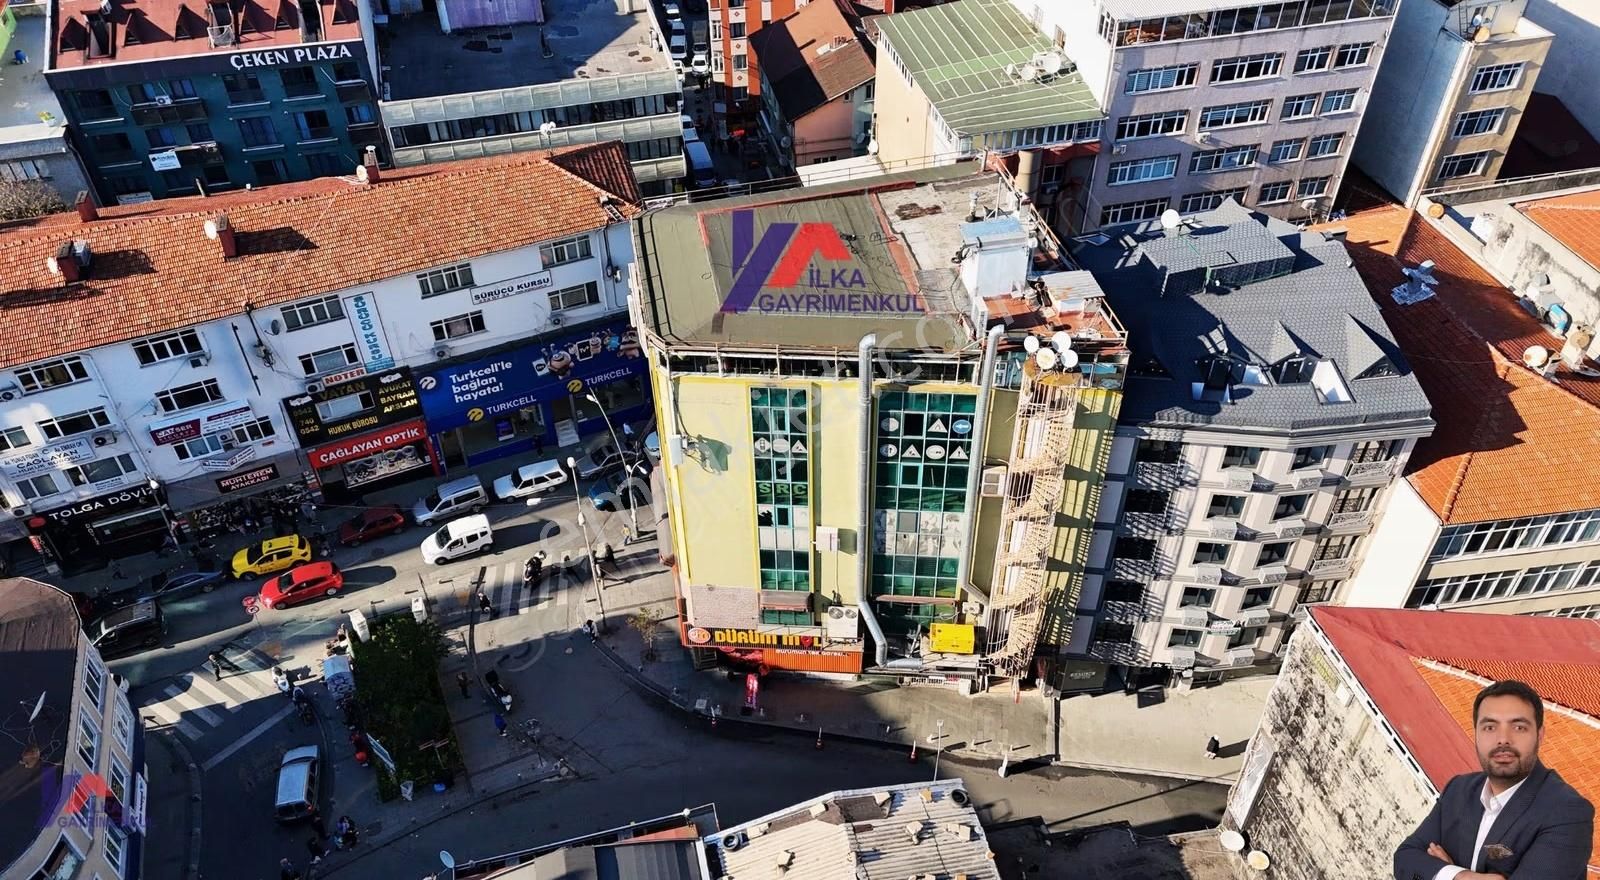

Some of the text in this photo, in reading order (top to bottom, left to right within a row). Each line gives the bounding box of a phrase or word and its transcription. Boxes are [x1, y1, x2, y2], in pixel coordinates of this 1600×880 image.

[230, 44, 352, 71] ÇEKEN PLAZA
[474, 286, 514, 301] SÜRÜCÜ
[517, 277, 550, 290] KURSU
[325, 368, 365, 385] NOTER
[449, 361, 513, 384] Turkcell'le
[585, 367, 633, 386] TURKCELL
[379, 381, 412, 394] AVUKAT
[452, 376, 497, 395] bağlan
[454, 383, 504, 405] hayata!
[380, 390, 415, 404] BAYRAM
[384, 398, 418, 413] ARSLAN
[486, 394, 537, 415] TURKCELL
[328, 422, 352, 436] HUKUK
[320, 428, 420, 463] ÇAĞLAYAN OPTİK
[221, 467, 275, 488] MUHTEREM
[758, 482, 808, 495] SRC
[49, 502, 104, 520] TOLGA
